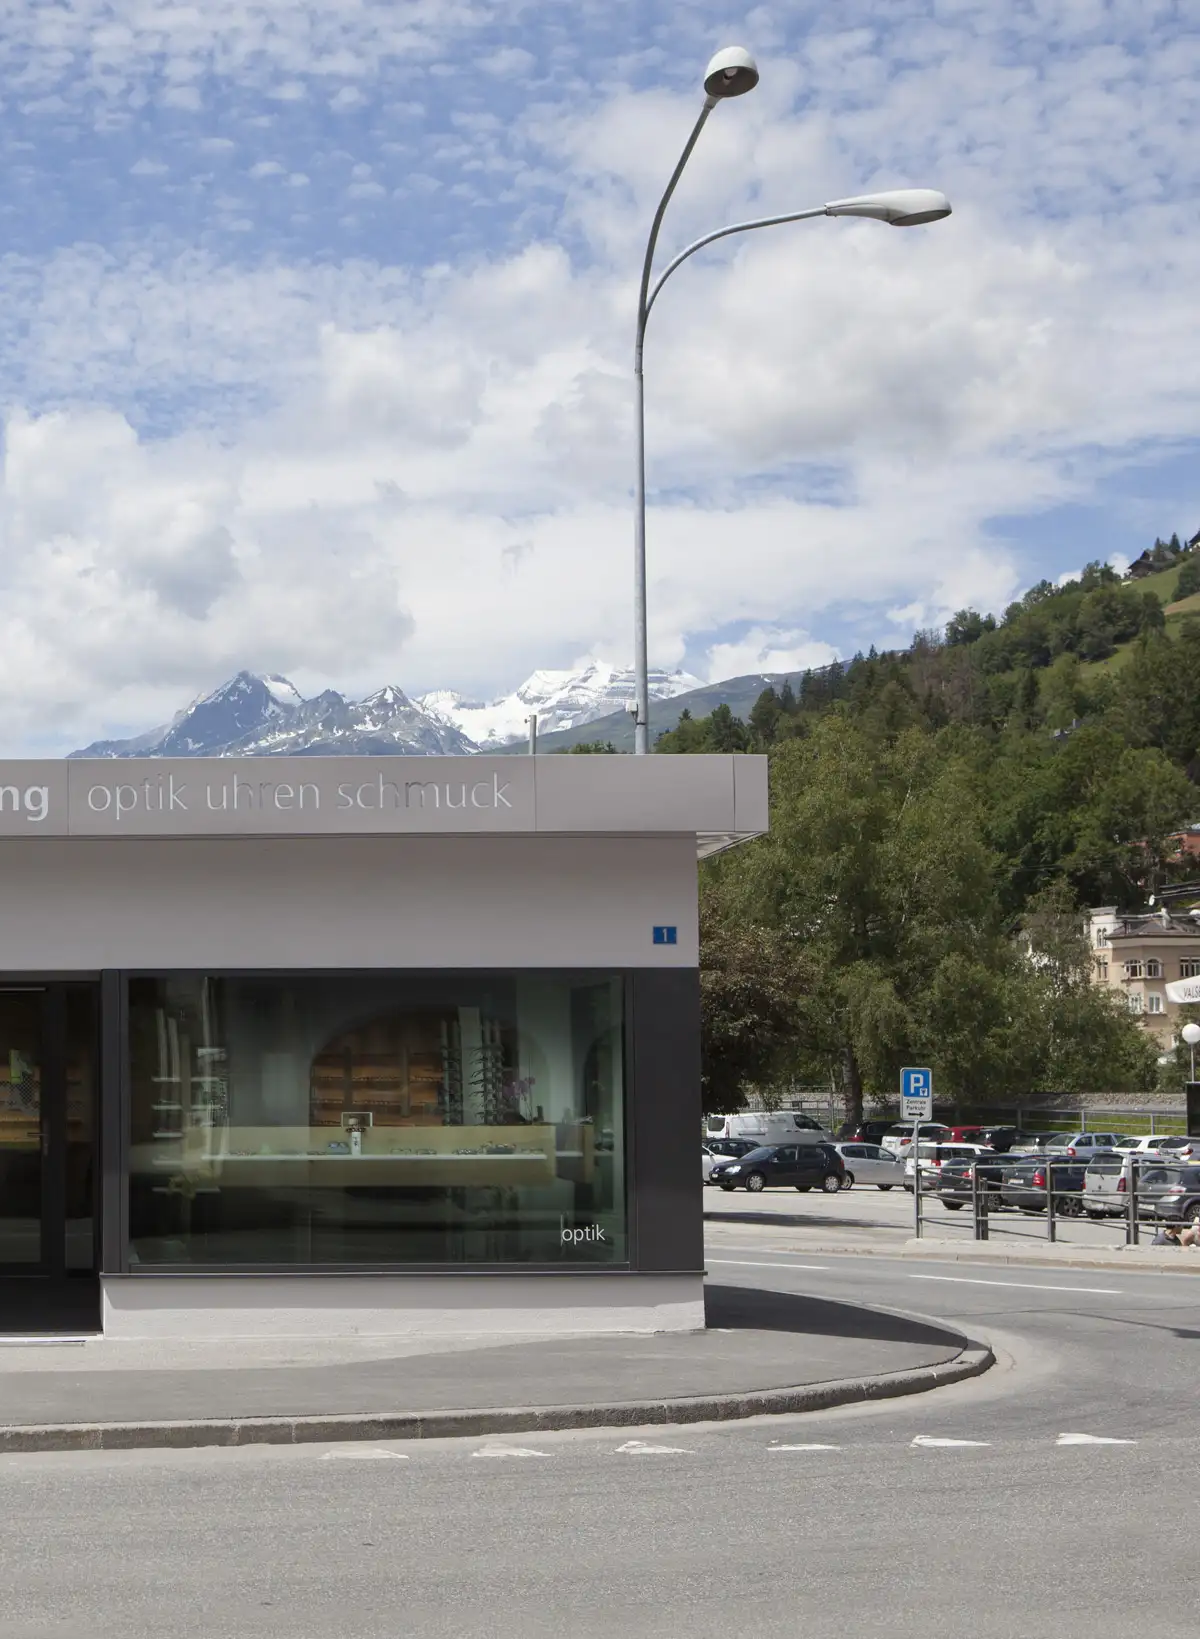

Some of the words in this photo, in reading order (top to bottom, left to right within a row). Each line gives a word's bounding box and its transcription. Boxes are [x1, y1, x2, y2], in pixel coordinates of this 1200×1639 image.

[87, 773, 188, 820] optik
[206, 773, 320, 811] uhren
[337, 772, 513, 809] schmuck
[662, 928, 668, 942] 1
[1183, 985, 1200, 998] VALS
[910, 1073, 924, 1094] P
[562, 1224, 606, 1245] optik
